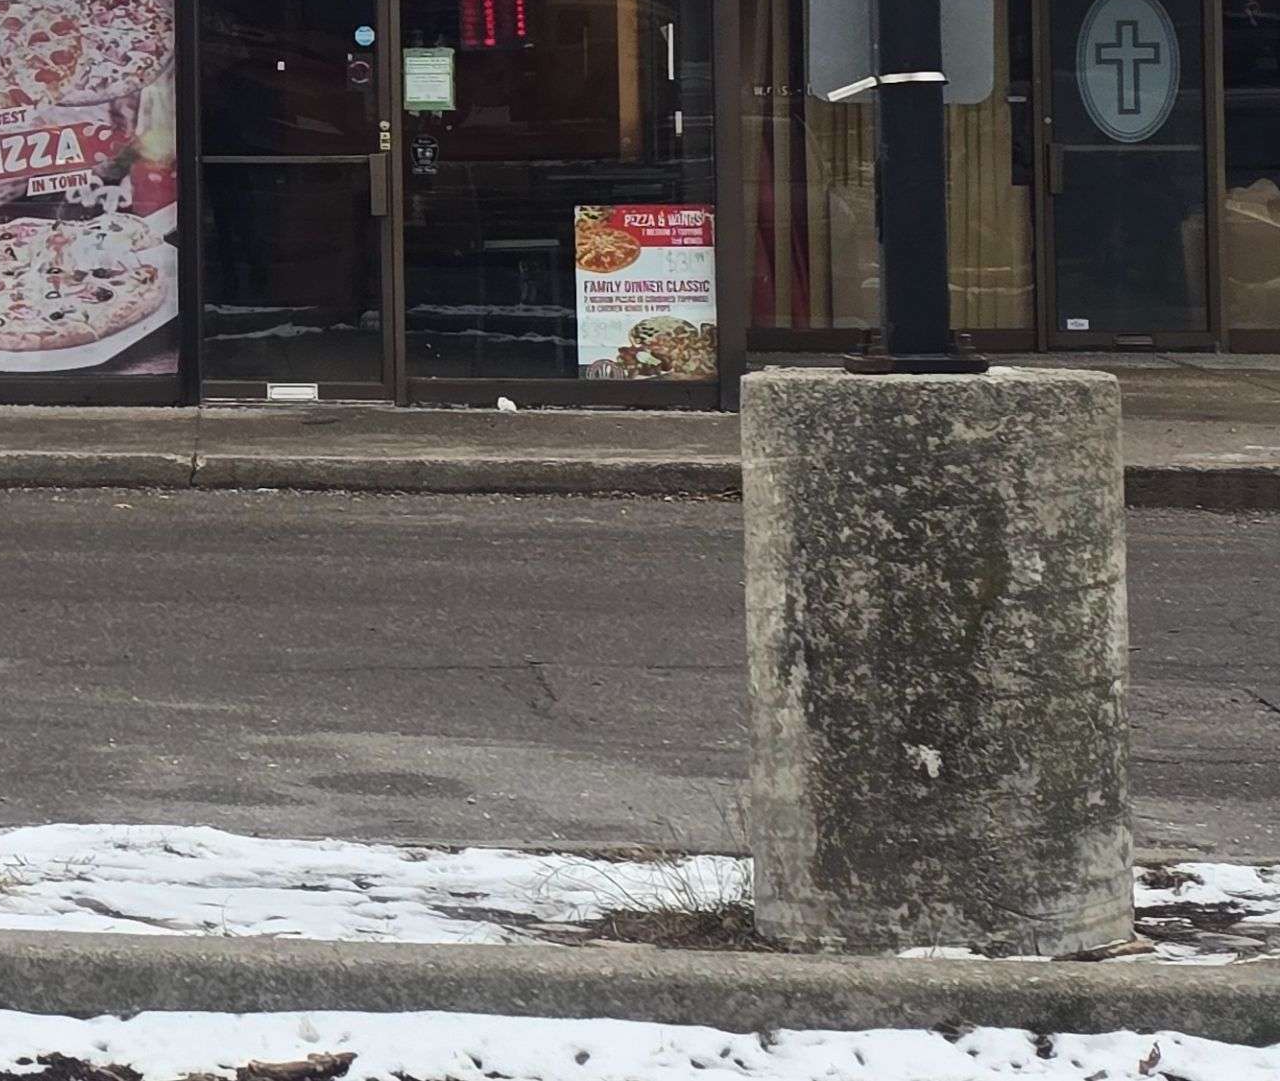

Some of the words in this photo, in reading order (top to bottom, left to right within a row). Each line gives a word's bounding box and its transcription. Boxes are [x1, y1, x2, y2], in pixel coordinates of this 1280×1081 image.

[31, 179, 46, 193] IN
[47, 173, 89, 191] TOWN
[624, 213, 655, 228] PIZZA
[583, 280, 621, 294] FAMILY
[624, 279, 664, 294] DINNER
[666, 279, 711, 294] CLASSIC
